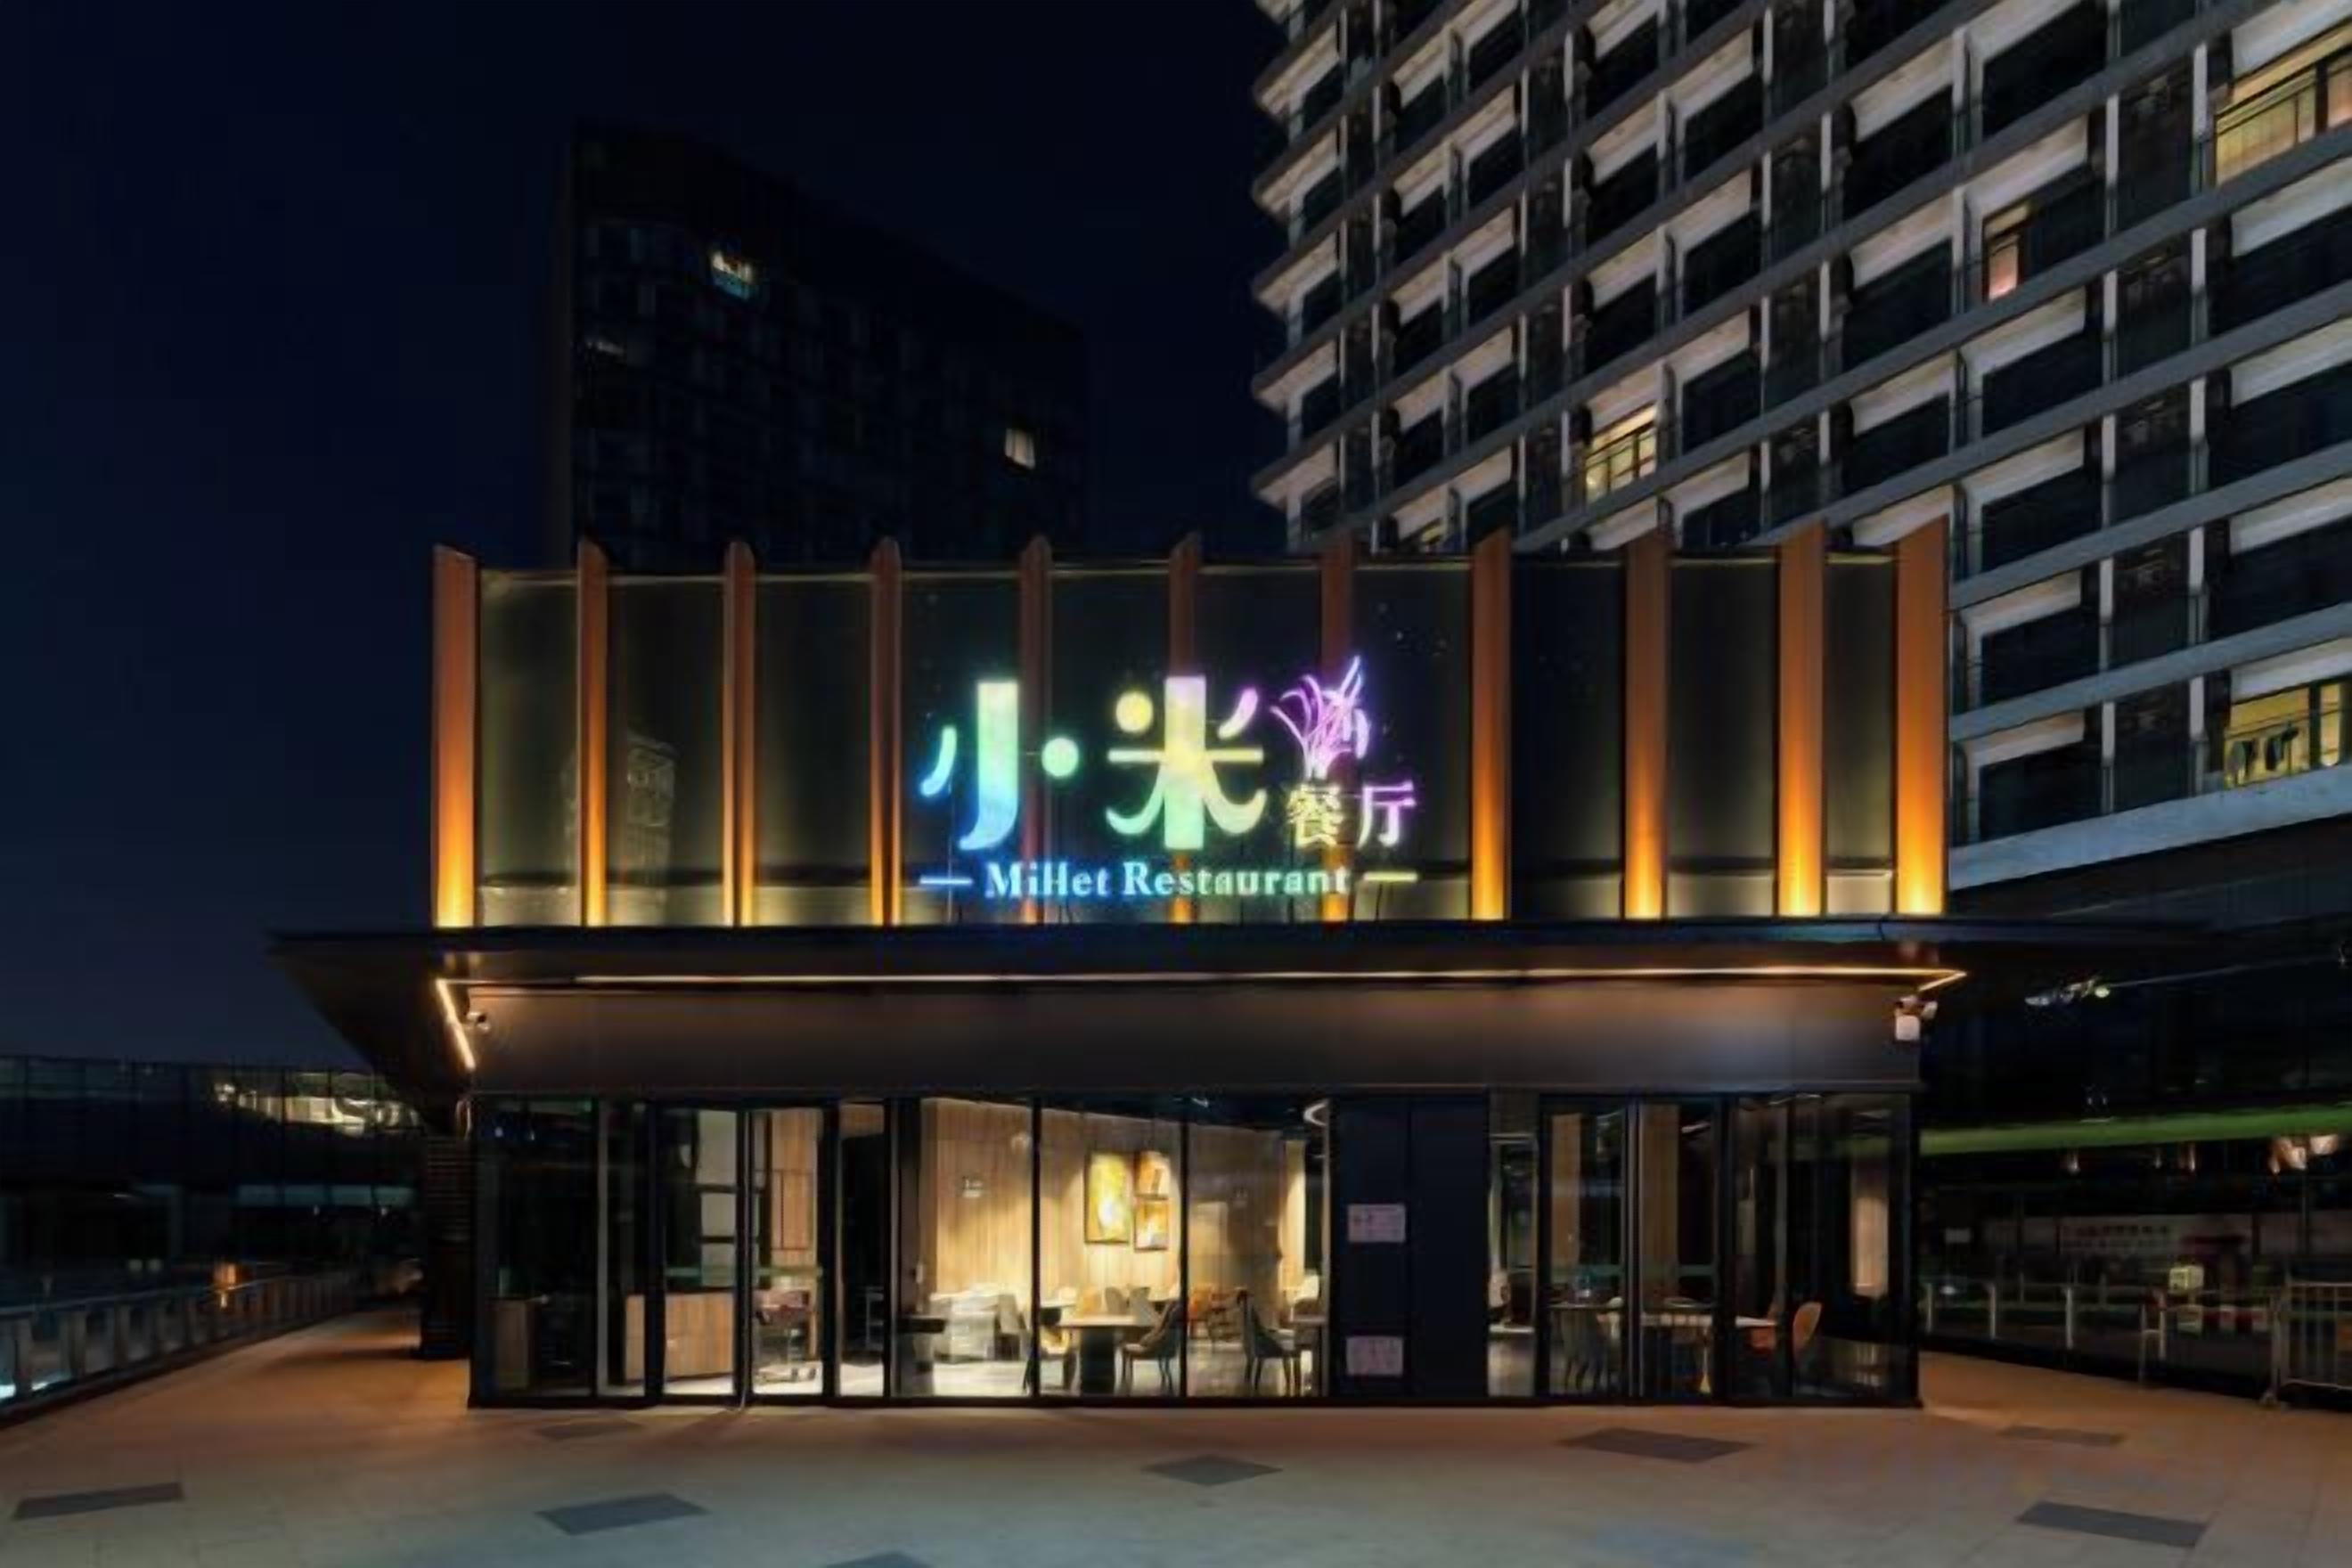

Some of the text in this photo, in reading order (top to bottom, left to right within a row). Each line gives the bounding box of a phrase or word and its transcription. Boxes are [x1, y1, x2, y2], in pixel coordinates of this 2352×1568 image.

[919, 674, 1267, 852] 小米
[1286, 780, 1417, 848] 餐厅
[984, 861, 1352, 898] Millet Restaurant
